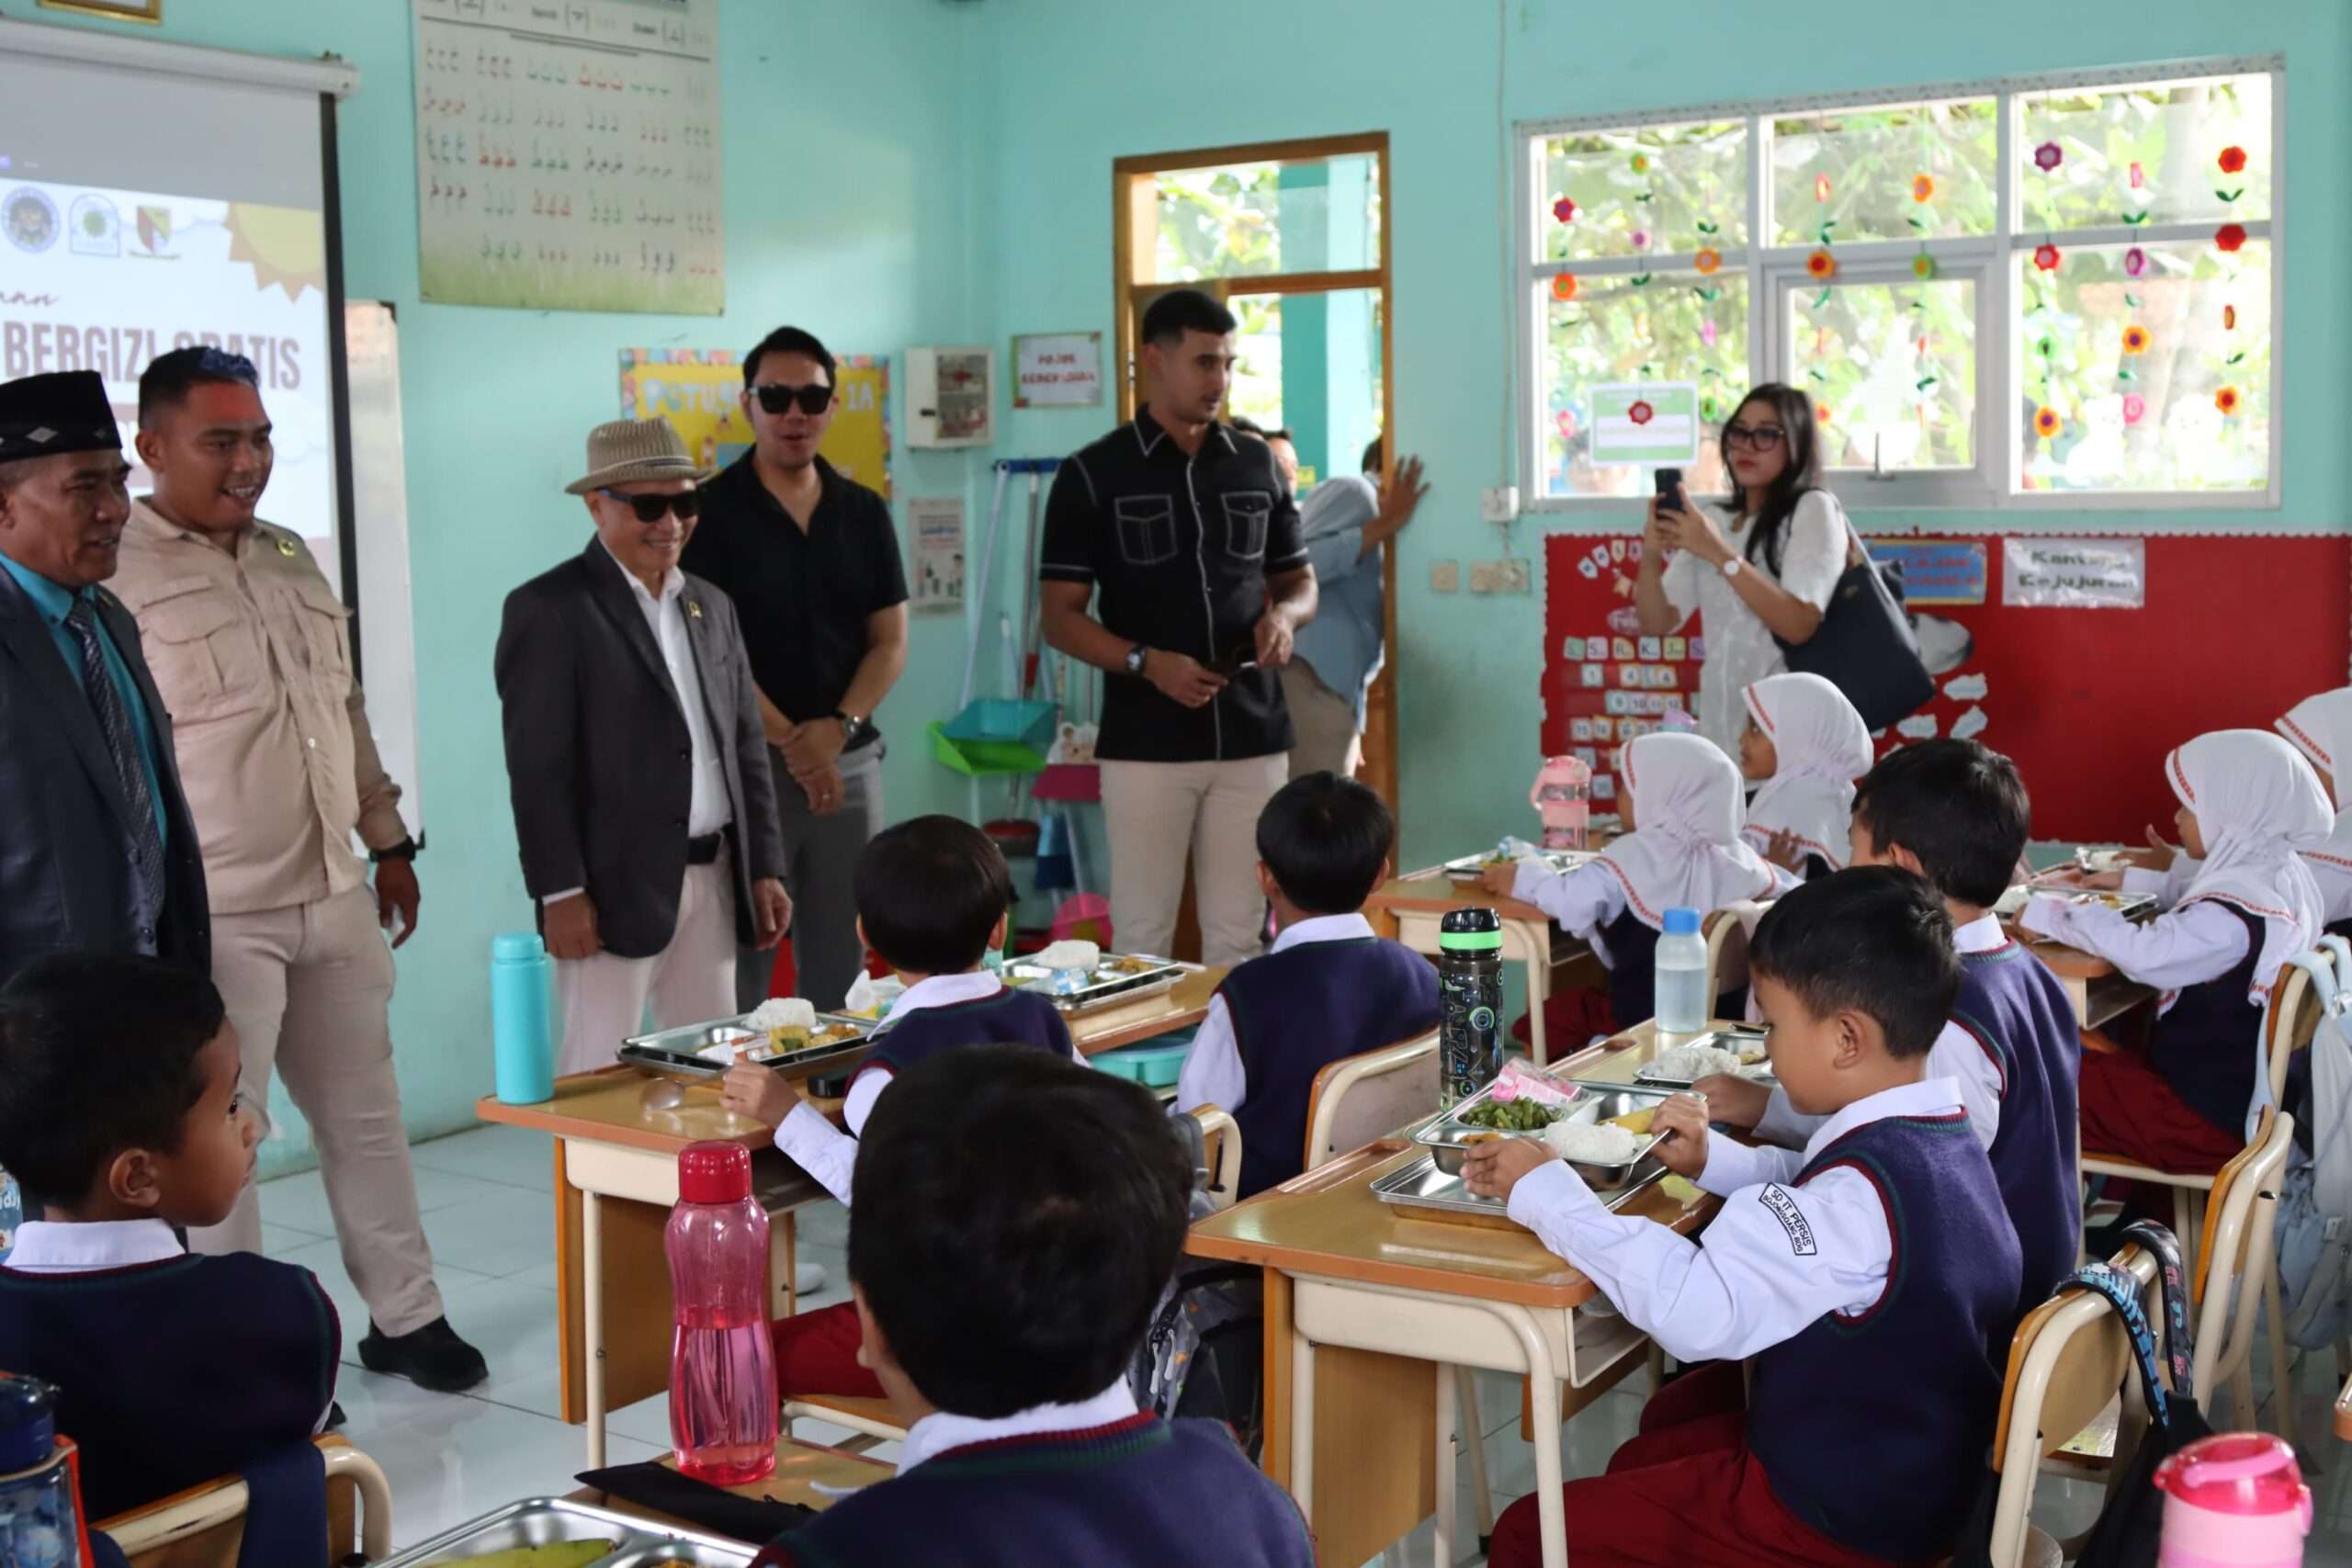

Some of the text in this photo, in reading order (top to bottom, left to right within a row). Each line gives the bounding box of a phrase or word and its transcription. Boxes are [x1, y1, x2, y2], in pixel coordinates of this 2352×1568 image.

[1771, 1190, 1812, 1247] SD IT PERSIS
